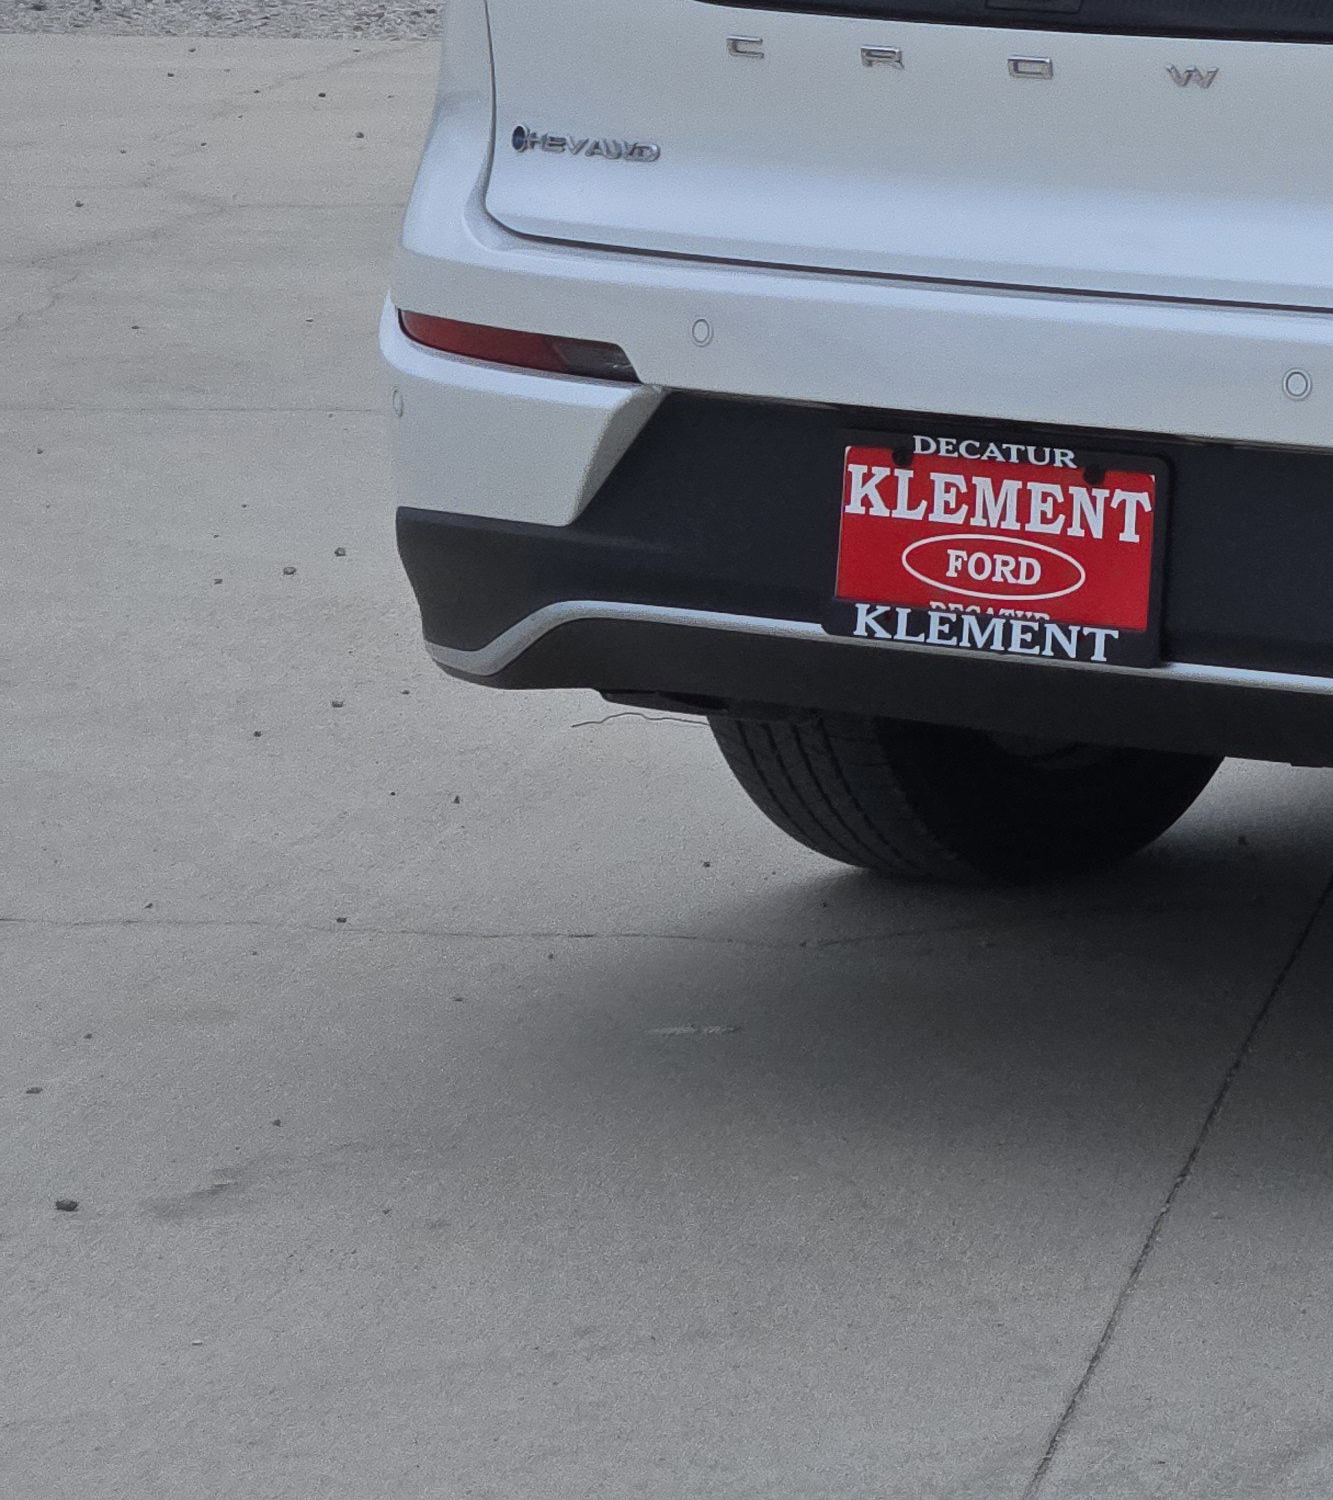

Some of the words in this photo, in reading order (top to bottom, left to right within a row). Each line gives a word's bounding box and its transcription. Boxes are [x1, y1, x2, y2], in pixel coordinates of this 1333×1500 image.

[913, 435, 1078, 469] DECATUR
[845, 464, 1152, 543] KLEMENT
[946, 549, 1042, 585] FORD
[853, 603, 1119, 662] KLEMENT
